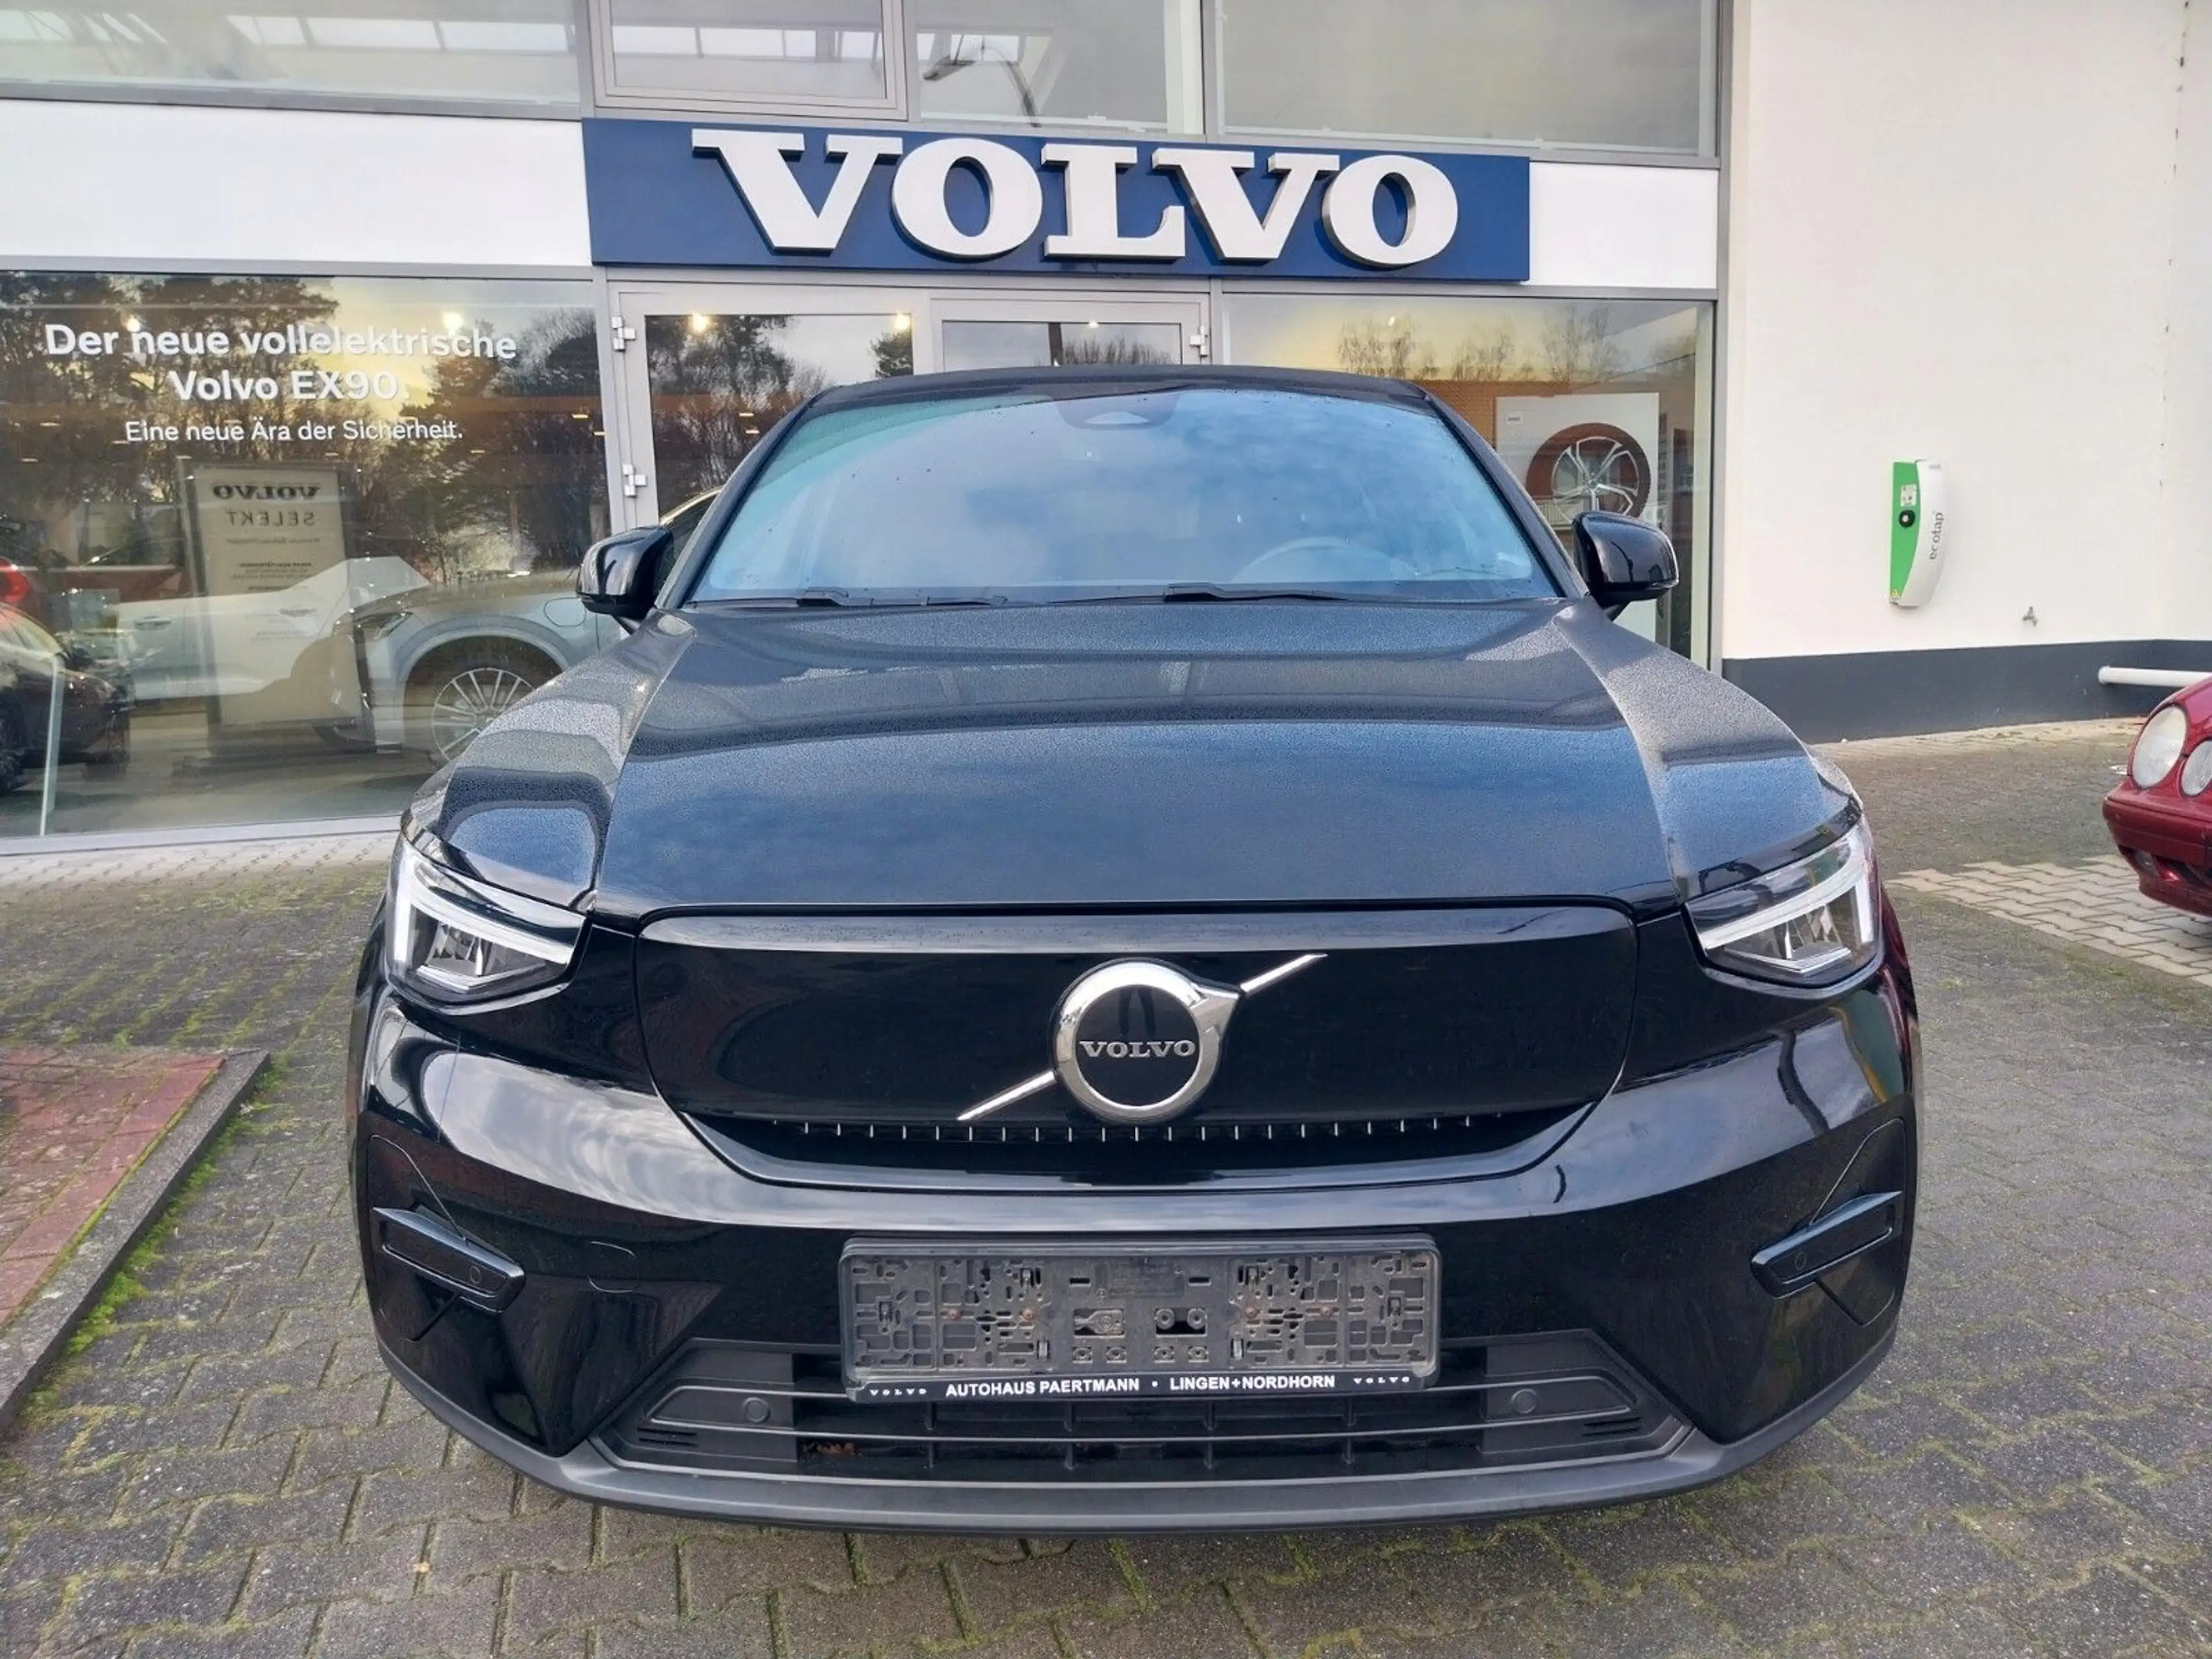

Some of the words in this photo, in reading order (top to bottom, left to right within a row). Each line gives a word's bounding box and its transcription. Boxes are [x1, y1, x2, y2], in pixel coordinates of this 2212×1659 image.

[692, 128, 1459, 267] VOLVO
[44, 323, 119, 355] Der
[131, 331, 229, 355] neue
[240, 324, 517, 359] vollelektrische
[169, 369, 278, 401] Volvo
[124, 419, 179, 442] Eine
[186, 426, 244, 441] neue
[250, 416, 292, 441] Ära
[298, 421, 335, 440] der
[343, 419, 464, 440] Sicherheit.
[1930, 512, 1944, 559] ecotap
[1079, 1040, 1195, 1058] VOLVO
[945, 1381, 1036, 1397] AUTOHAUS
[1039, 1378, 1140, 1393] PAERTMANN
[1169, 1375, 1335, 1391] LINGEN+NORDHORN
[1353, 1376, 1410, 1384] VOLVO
